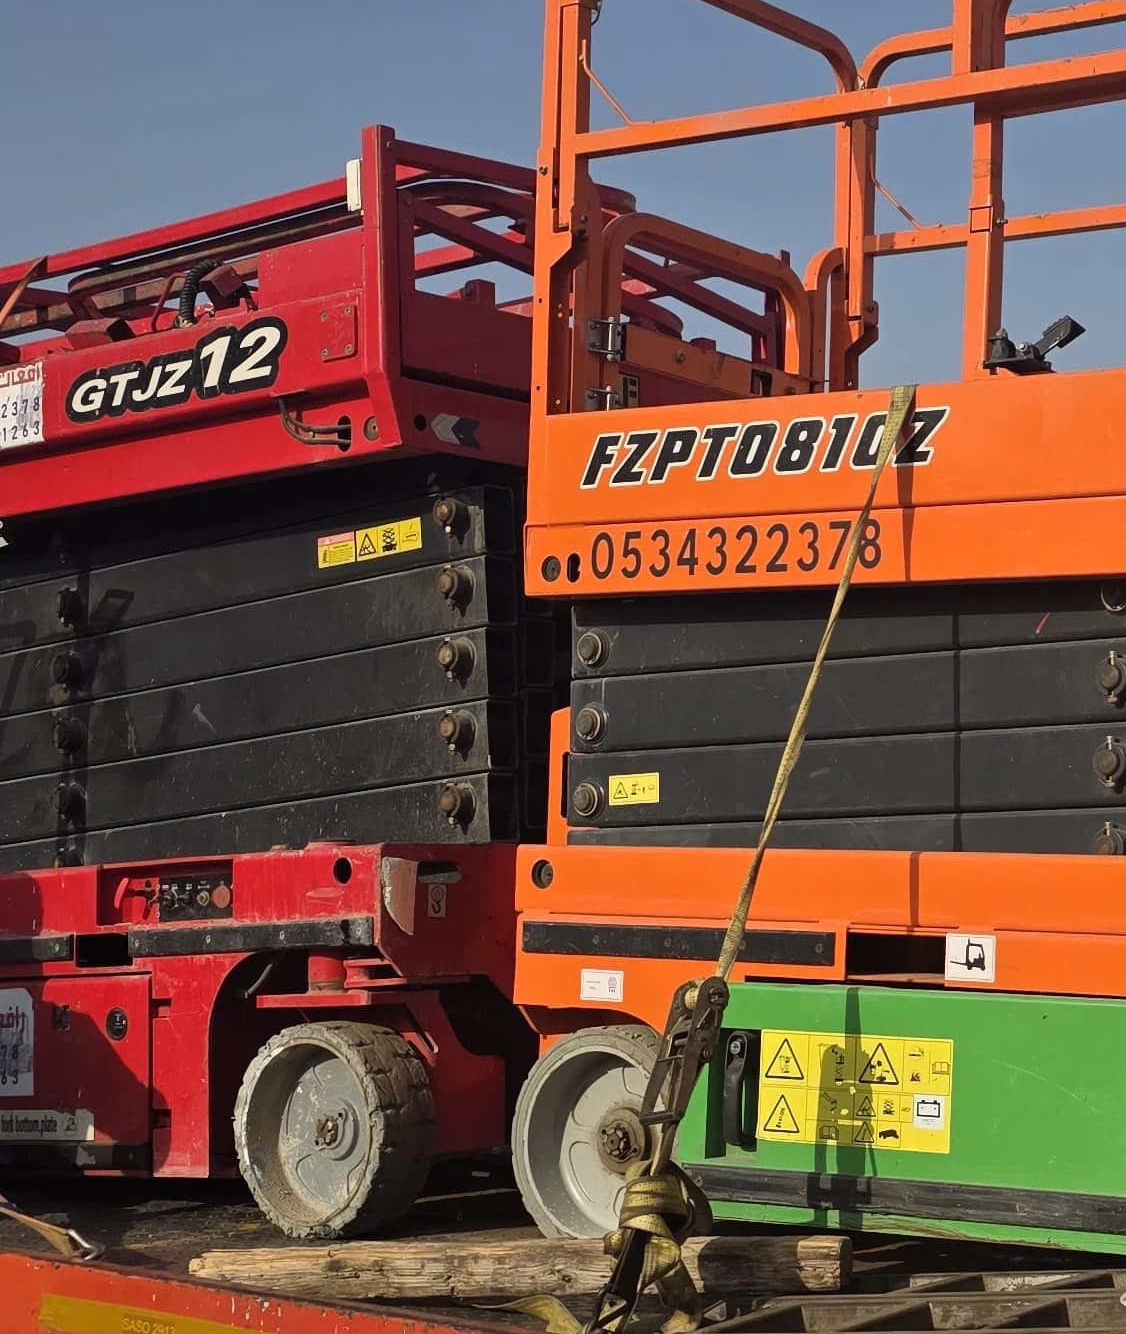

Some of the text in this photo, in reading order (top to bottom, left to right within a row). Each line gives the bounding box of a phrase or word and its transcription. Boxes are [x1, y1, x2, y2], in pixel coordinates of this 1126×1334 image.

[70, 323, 282, 417] GTJZ12
[591, 518, 882, 579] 0534322378
[121, 1318, 150, 1334] SASO
